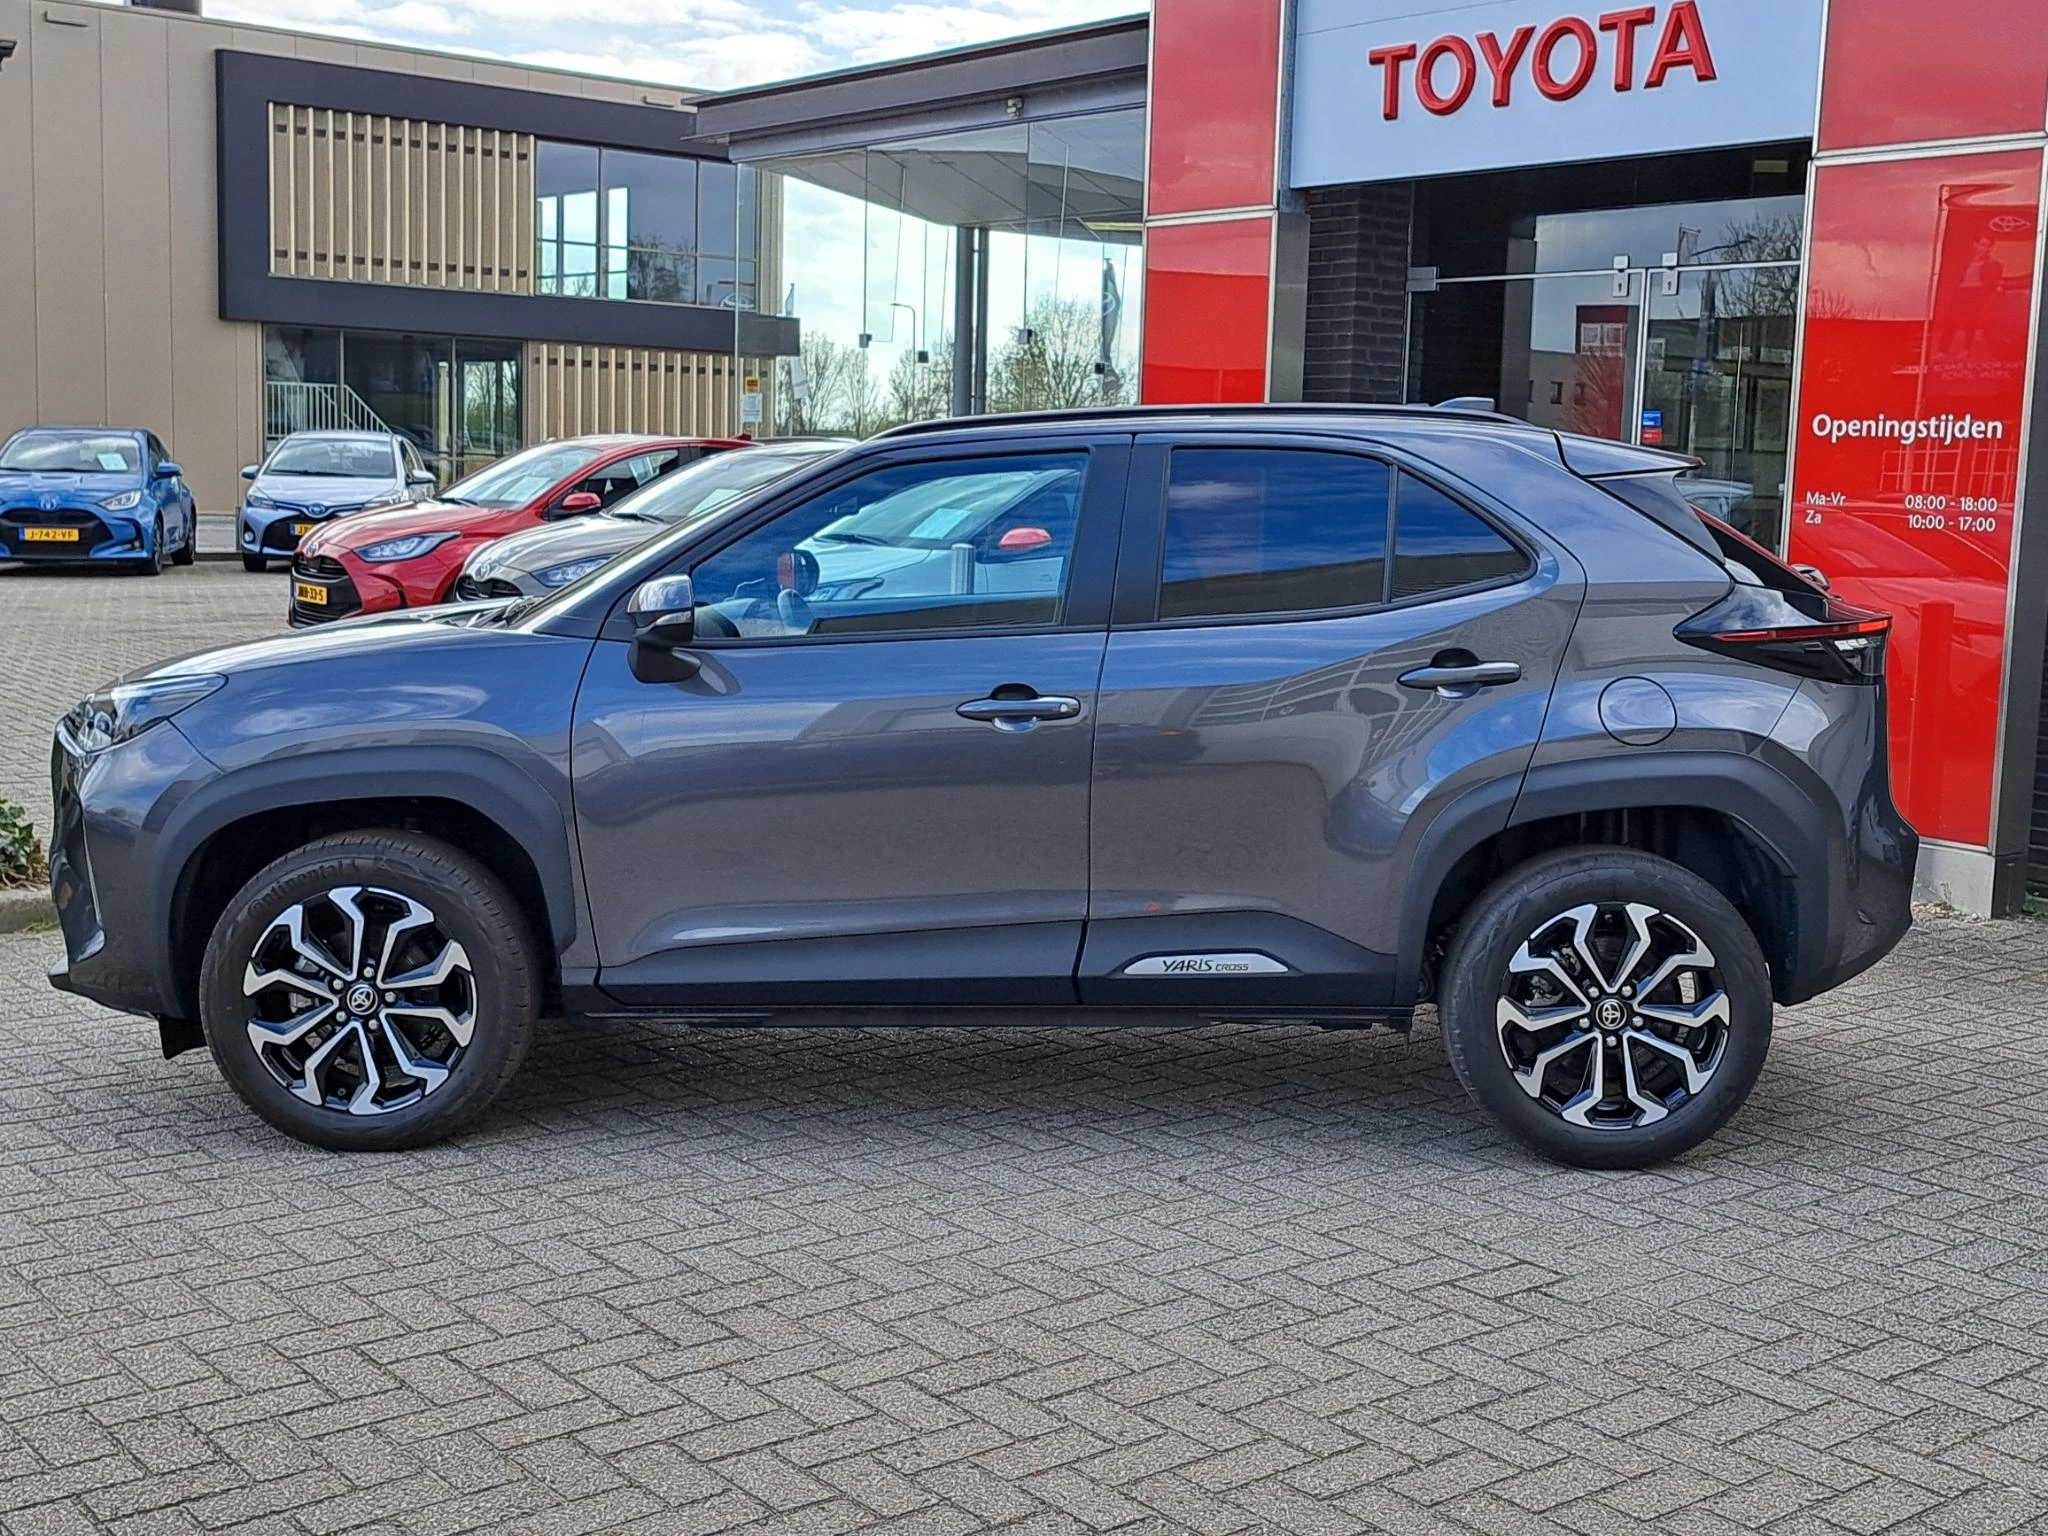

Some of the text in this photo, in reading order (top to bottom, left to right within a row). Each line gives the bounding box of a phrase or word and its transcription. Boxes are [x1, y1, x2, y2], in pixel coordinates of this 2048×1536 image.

[1369, 0, 1717, 120] TOYOTA
[1812, 413, 2003, 445] Openingstijden
[1806, 491, 1847, 507] Ma-Vr
[1905, 494, 1946, 510] 08:00
[1960, 497, 1998, 512] 18:00
[1805, 509, 1822, 525] Za
[1908, 514, 1945, 530] 10:00
[1958, 516, 1996, 532] 17:00
[1162, 958, 1249, 973] YARIS CROSS
